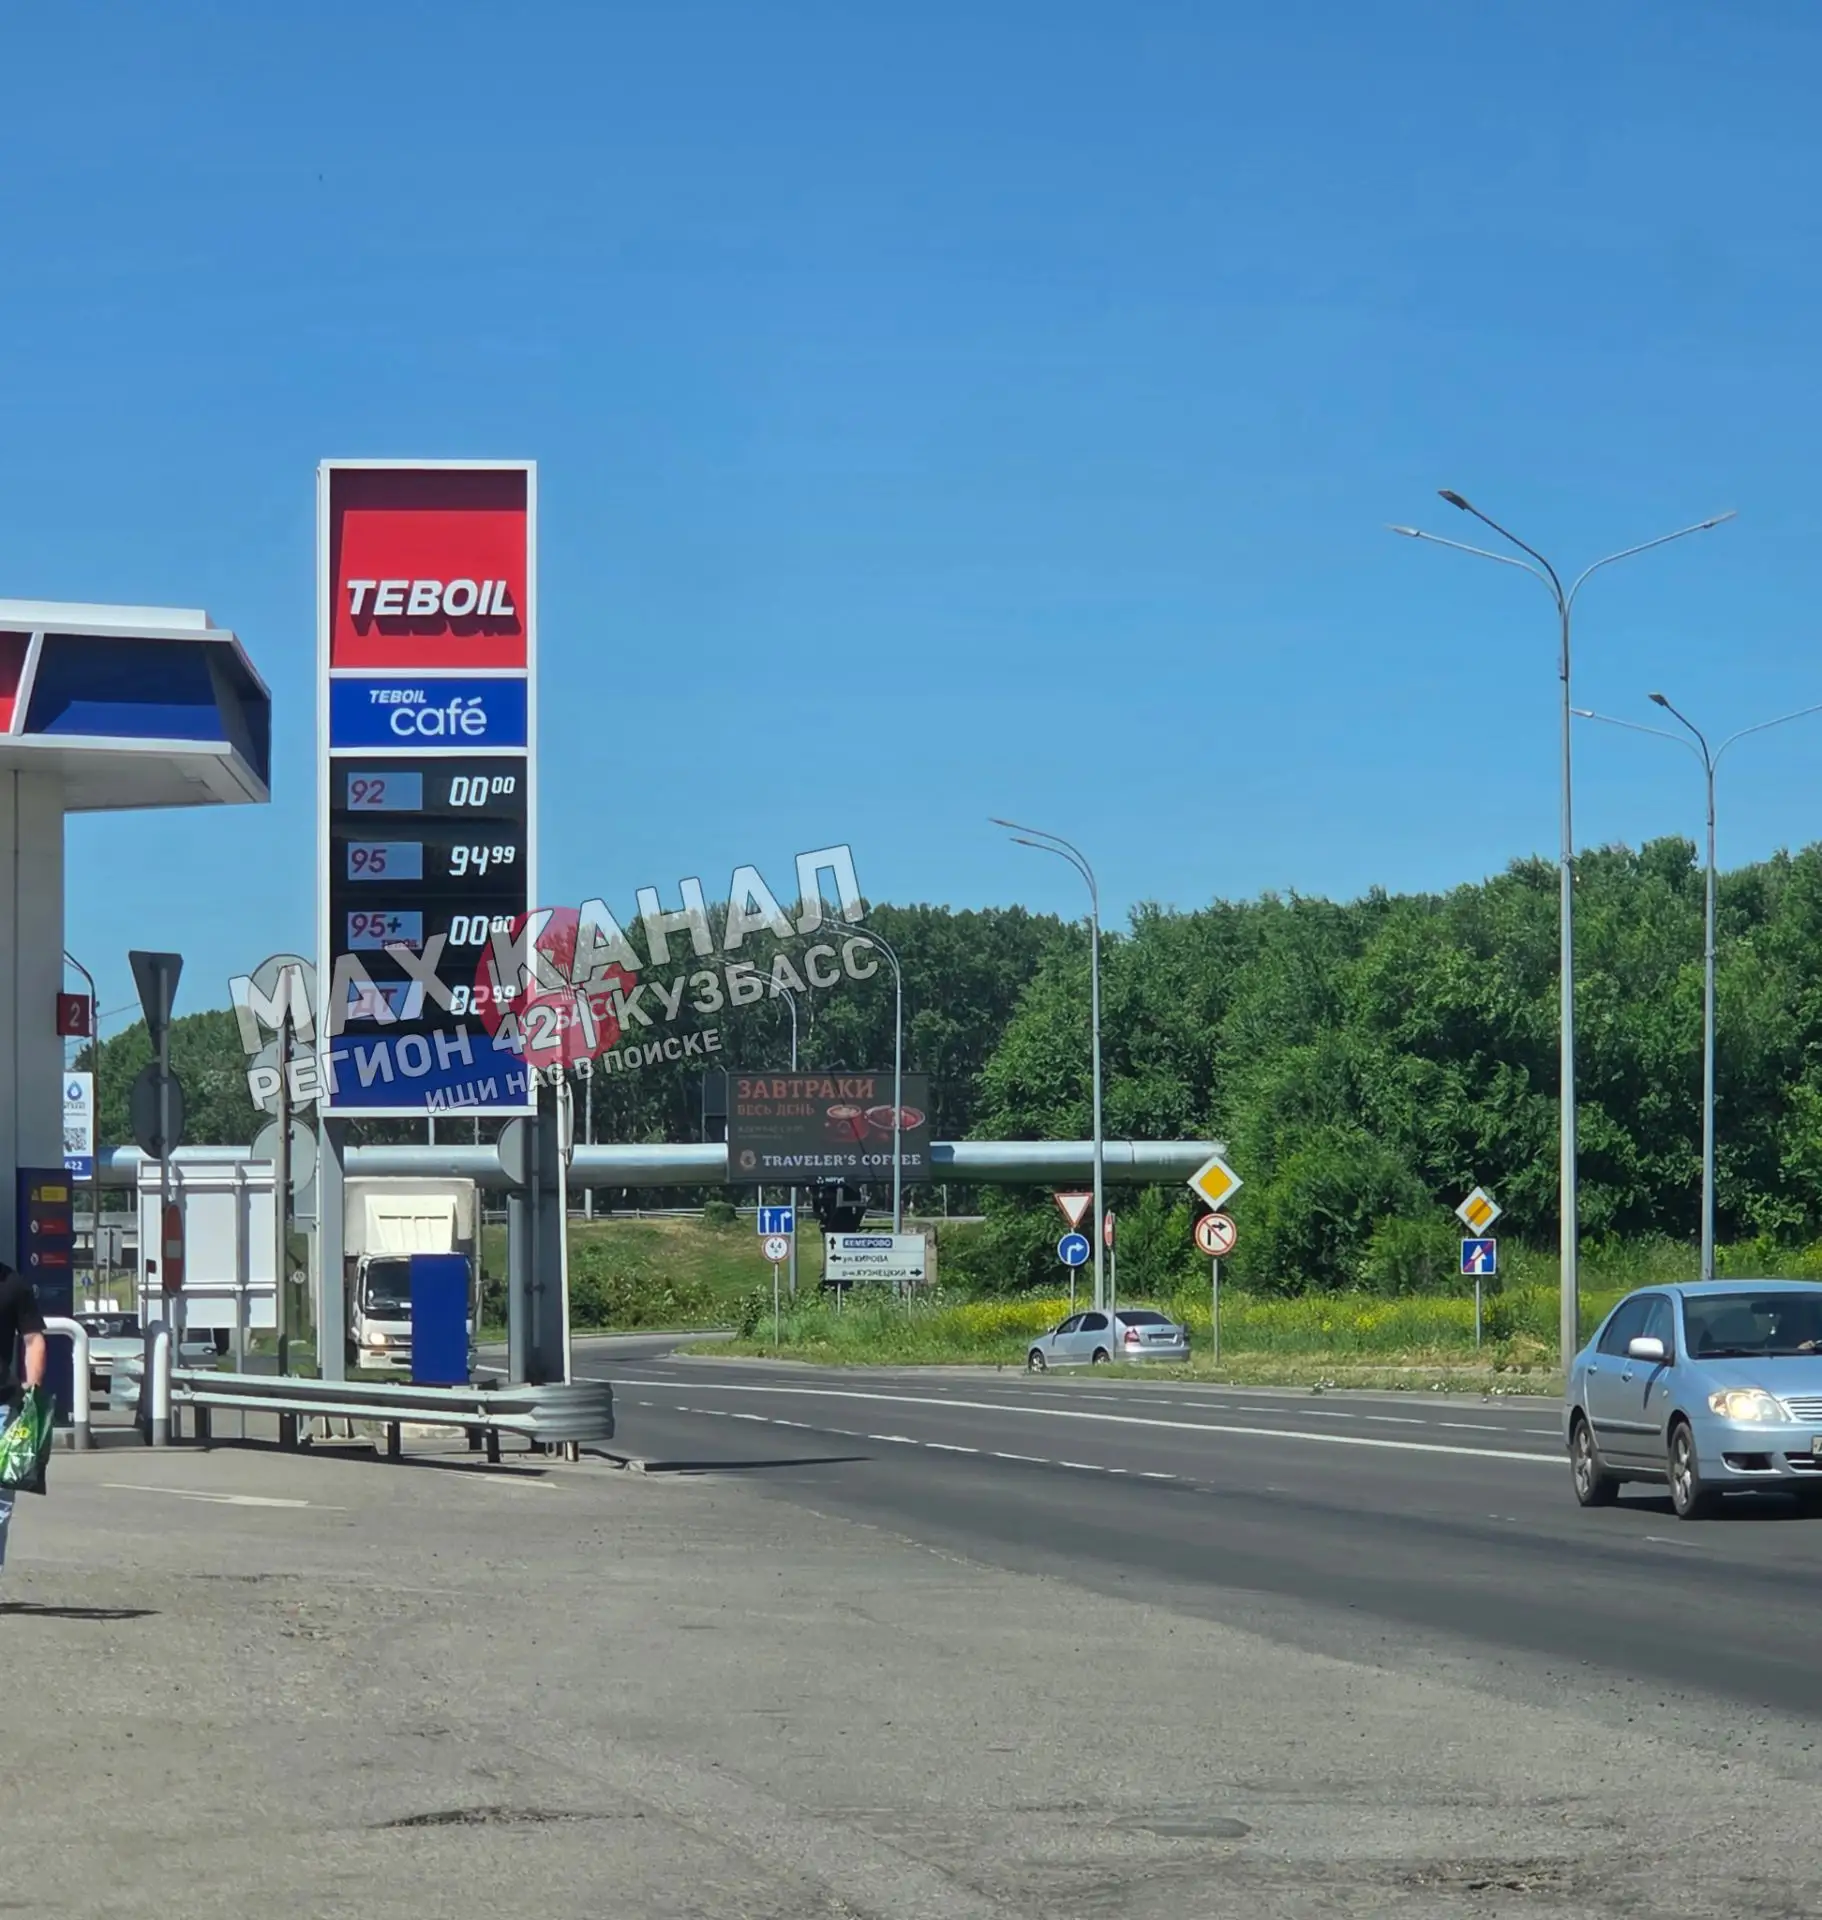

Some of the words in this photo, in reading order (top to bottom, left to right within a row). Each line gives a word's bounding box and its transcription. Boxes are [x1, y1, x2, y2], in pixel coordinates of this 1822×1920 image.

[347, 579, 515, 617] TEBOIL
[369, 690, 428, 704] TEBOIL
[390, 696, 488, 737] café
[351, 779, 385, 804] 92
[351, 848, 387, 874] 95
[351, 913, 402, 938] 95+
[69, 1002, 81, 1028] 2
[737, 1079, 875, 1099] ЗАВТРАКИ
[762, 1154, 857, 1167] TRAVELER'S
[861, 1154, 922, 1167] COFEE
